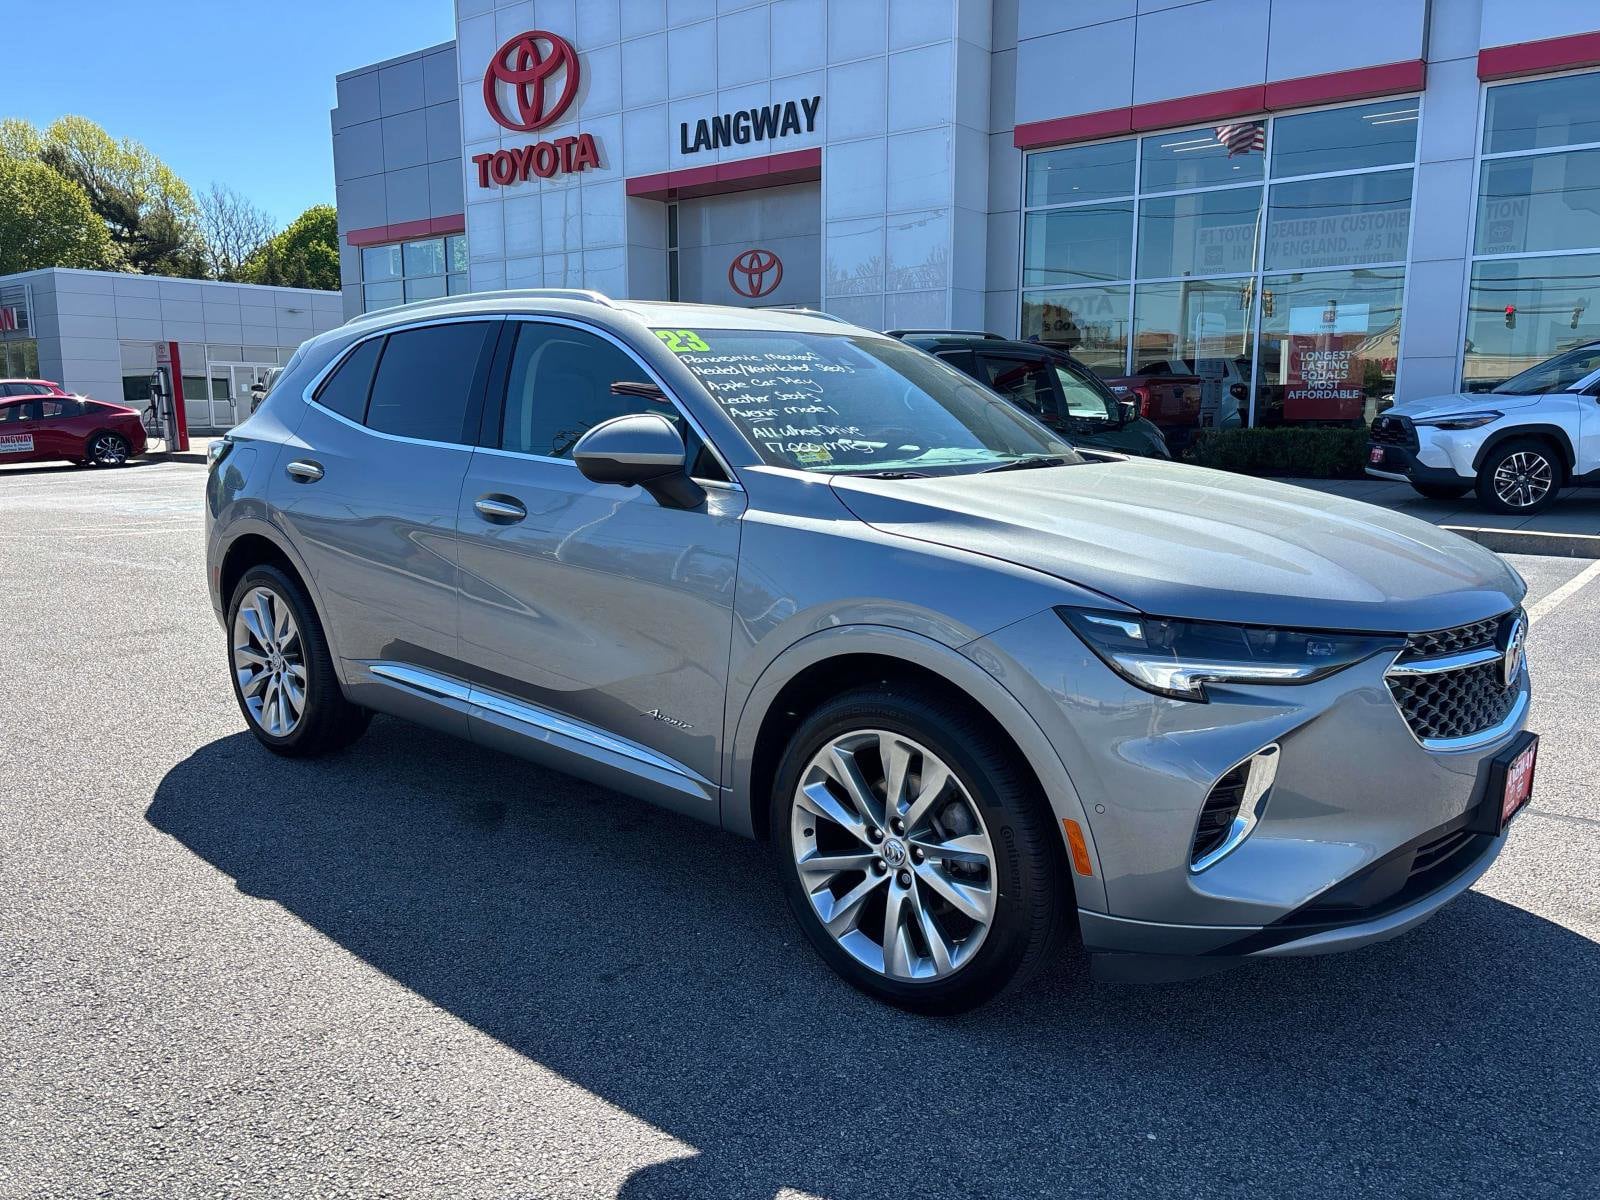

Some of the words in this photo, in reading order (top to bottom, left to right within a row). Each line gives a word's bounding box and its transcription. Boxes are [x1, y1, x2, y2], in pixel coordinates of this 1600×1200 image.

[680, 96, 820, 154] LANGWAY
[472, 133, 600, 188] TOYOTA
[1272, 220, 1317, 238] DEALER
[1322, 218, 1337, 234] IN
[655, 329, 711, 353] 23
[1300, 351, 1353, 361] LONGEST
[1301, 360, 1349, 371] LASTING
[1301, 370, 1348, 380] EQUALS
[706, 380, 750, 392] Apple
[1308, 380, 1340, 390] MOST
[718, 394, 769, 404] Leather
[1288, 390, 1360, 400] AFFORDABLE
[729, 407, 780, 418] Avenir
[0, 434, 32, 444] ANGWAY
[640, 709, 695, 729] Avenir
